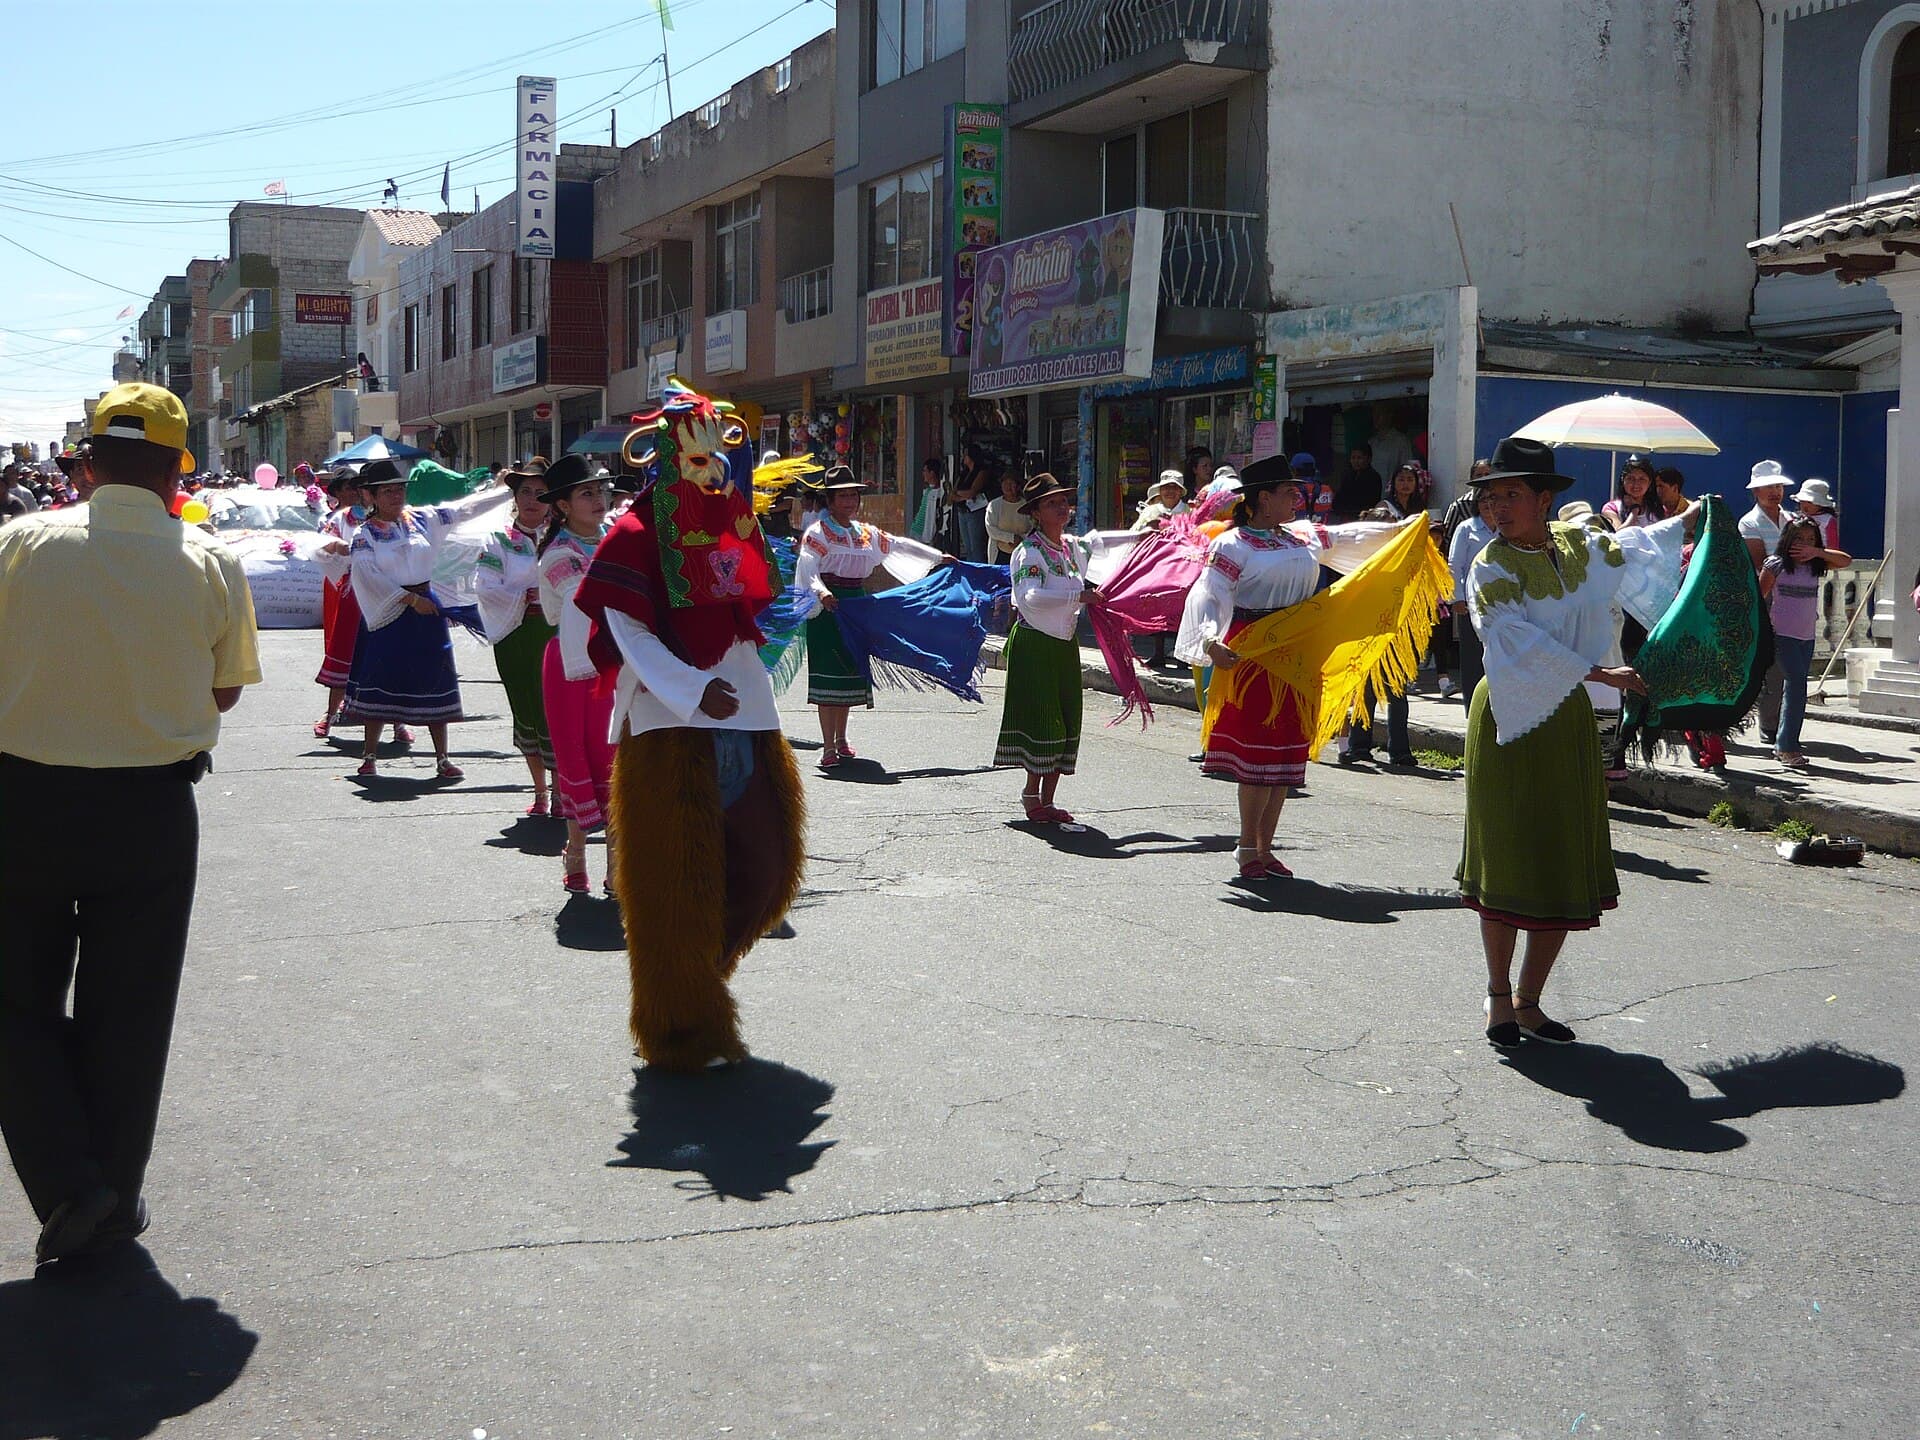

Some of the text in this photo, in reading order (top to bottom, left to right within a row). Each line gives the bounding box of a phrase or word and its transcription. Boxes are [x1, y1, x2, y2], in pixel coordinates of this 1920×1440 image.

[526, 93, 551, 238] FARMACIA
[298, 297, 350, 313] MI QUINTA
[972, 351, 1122, 392] DISTRIBUIDORA DE PAÑALES M.B.
